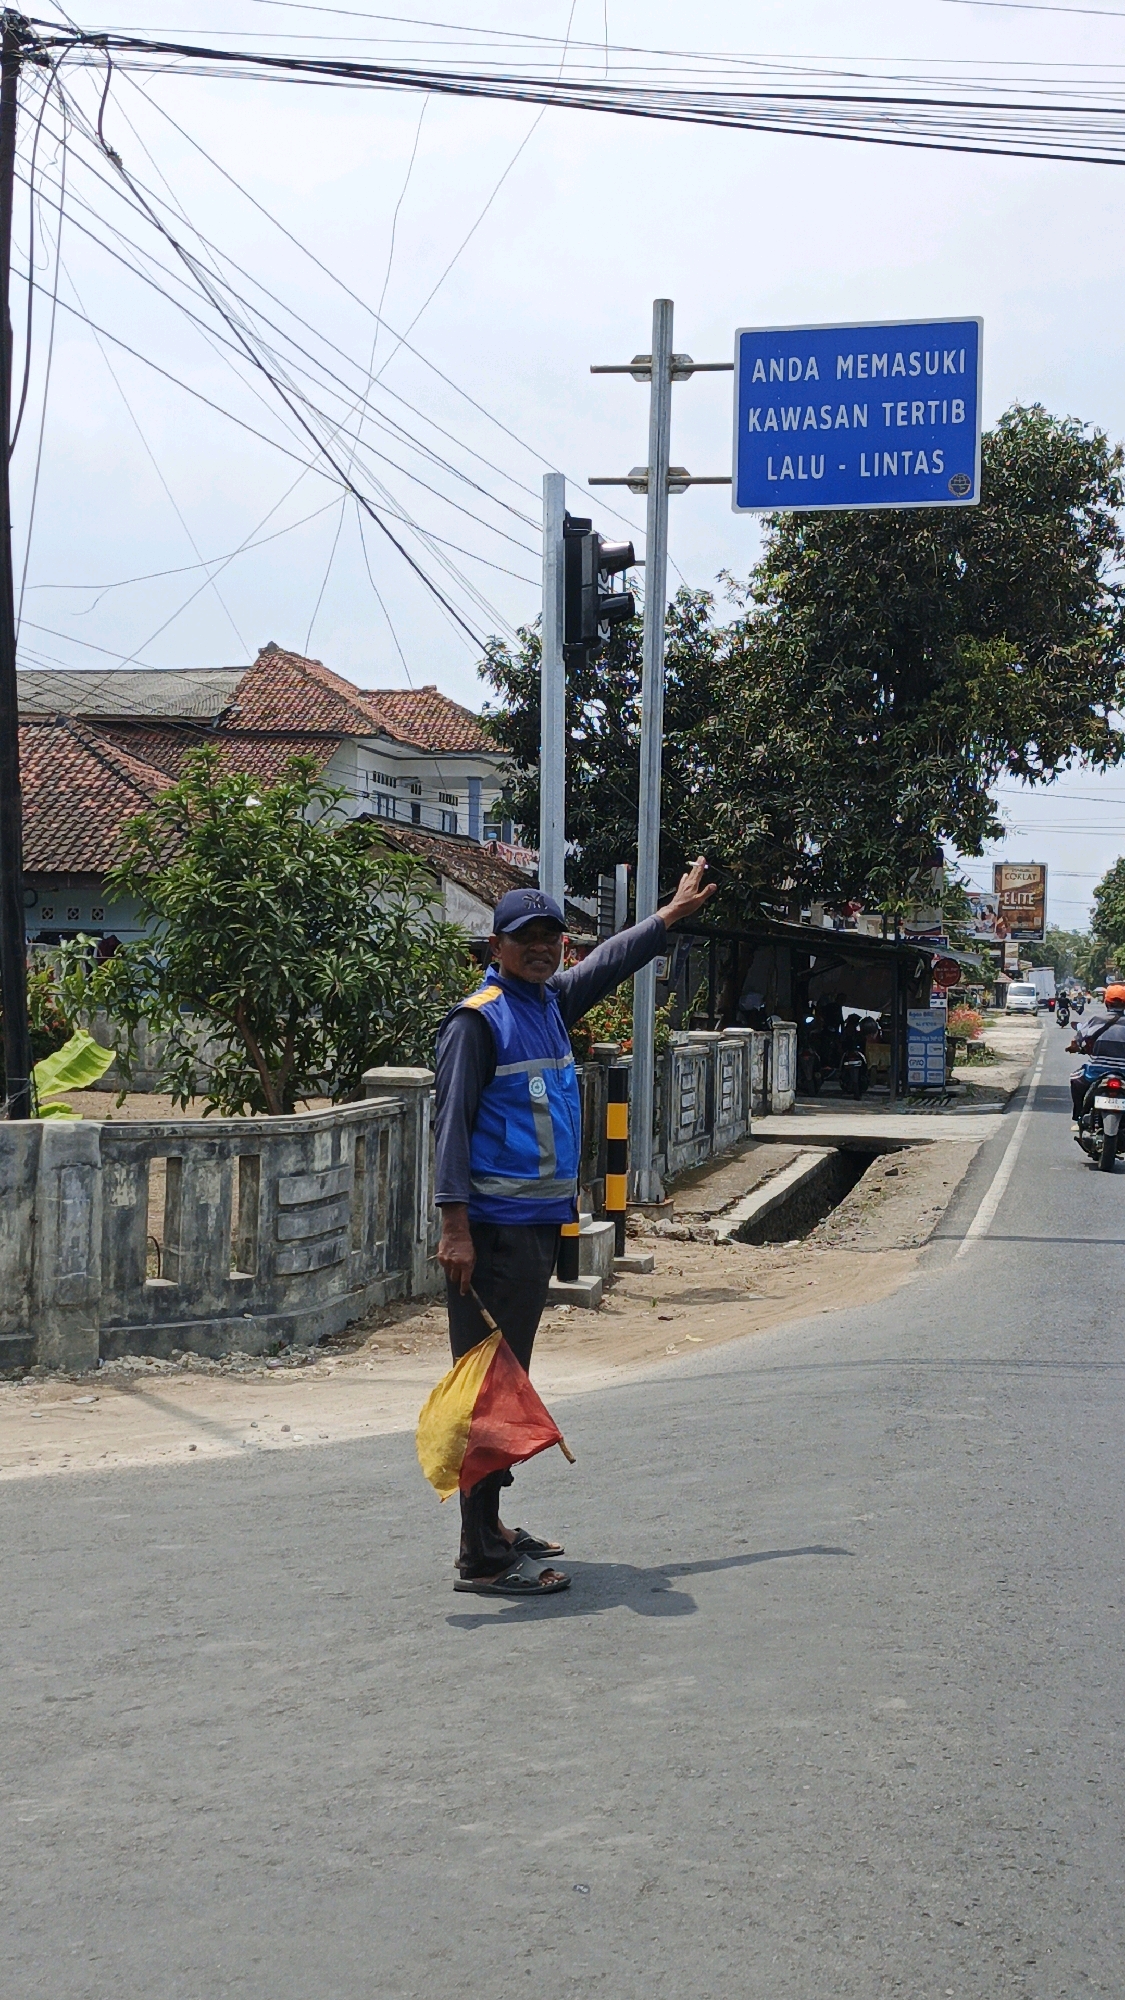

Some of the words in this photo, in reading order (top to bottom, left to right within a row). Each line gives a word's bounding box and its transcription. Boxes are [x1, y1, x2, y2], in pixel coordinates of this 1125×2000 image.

[752, 356, 820, 383] ANDA
[836, 348, 965, 380] MEMASUKI
[748, 403, 868, 432] KAWASAN
[881, 398, 965, 427] TERTIB
[767, 454, 825, 481] LALU
[860, 449, 945, 477] LINTAS
[1004, 872, 1037, 881] COKLAT
[1004, 892, 1036, 905] ELITE
